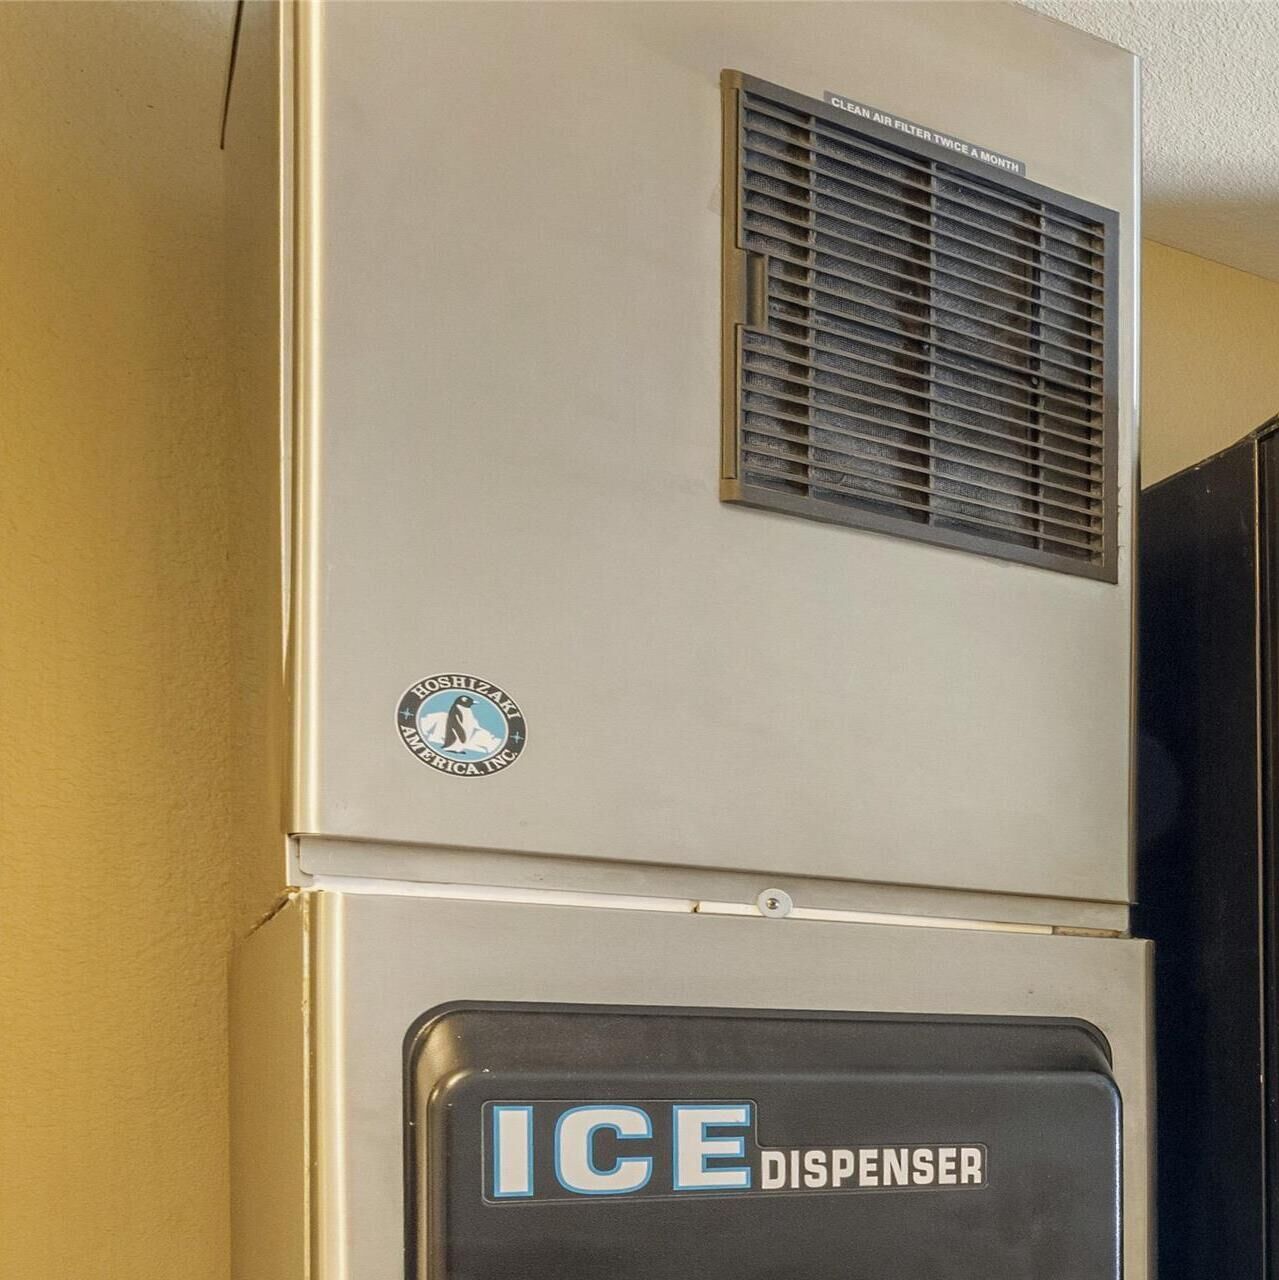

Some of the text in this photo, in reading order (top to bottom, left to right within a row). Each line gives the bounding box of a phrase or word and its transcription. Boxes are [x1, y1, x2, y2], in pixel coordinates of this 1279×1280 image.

[831, 97, 1019, 172] CLEAN AIR FILTER TWICE A MONTH
[410, 675, 522, 720] HOSHIZAKI
[492, 1103, 983, 1198] ICE DISPENSER
